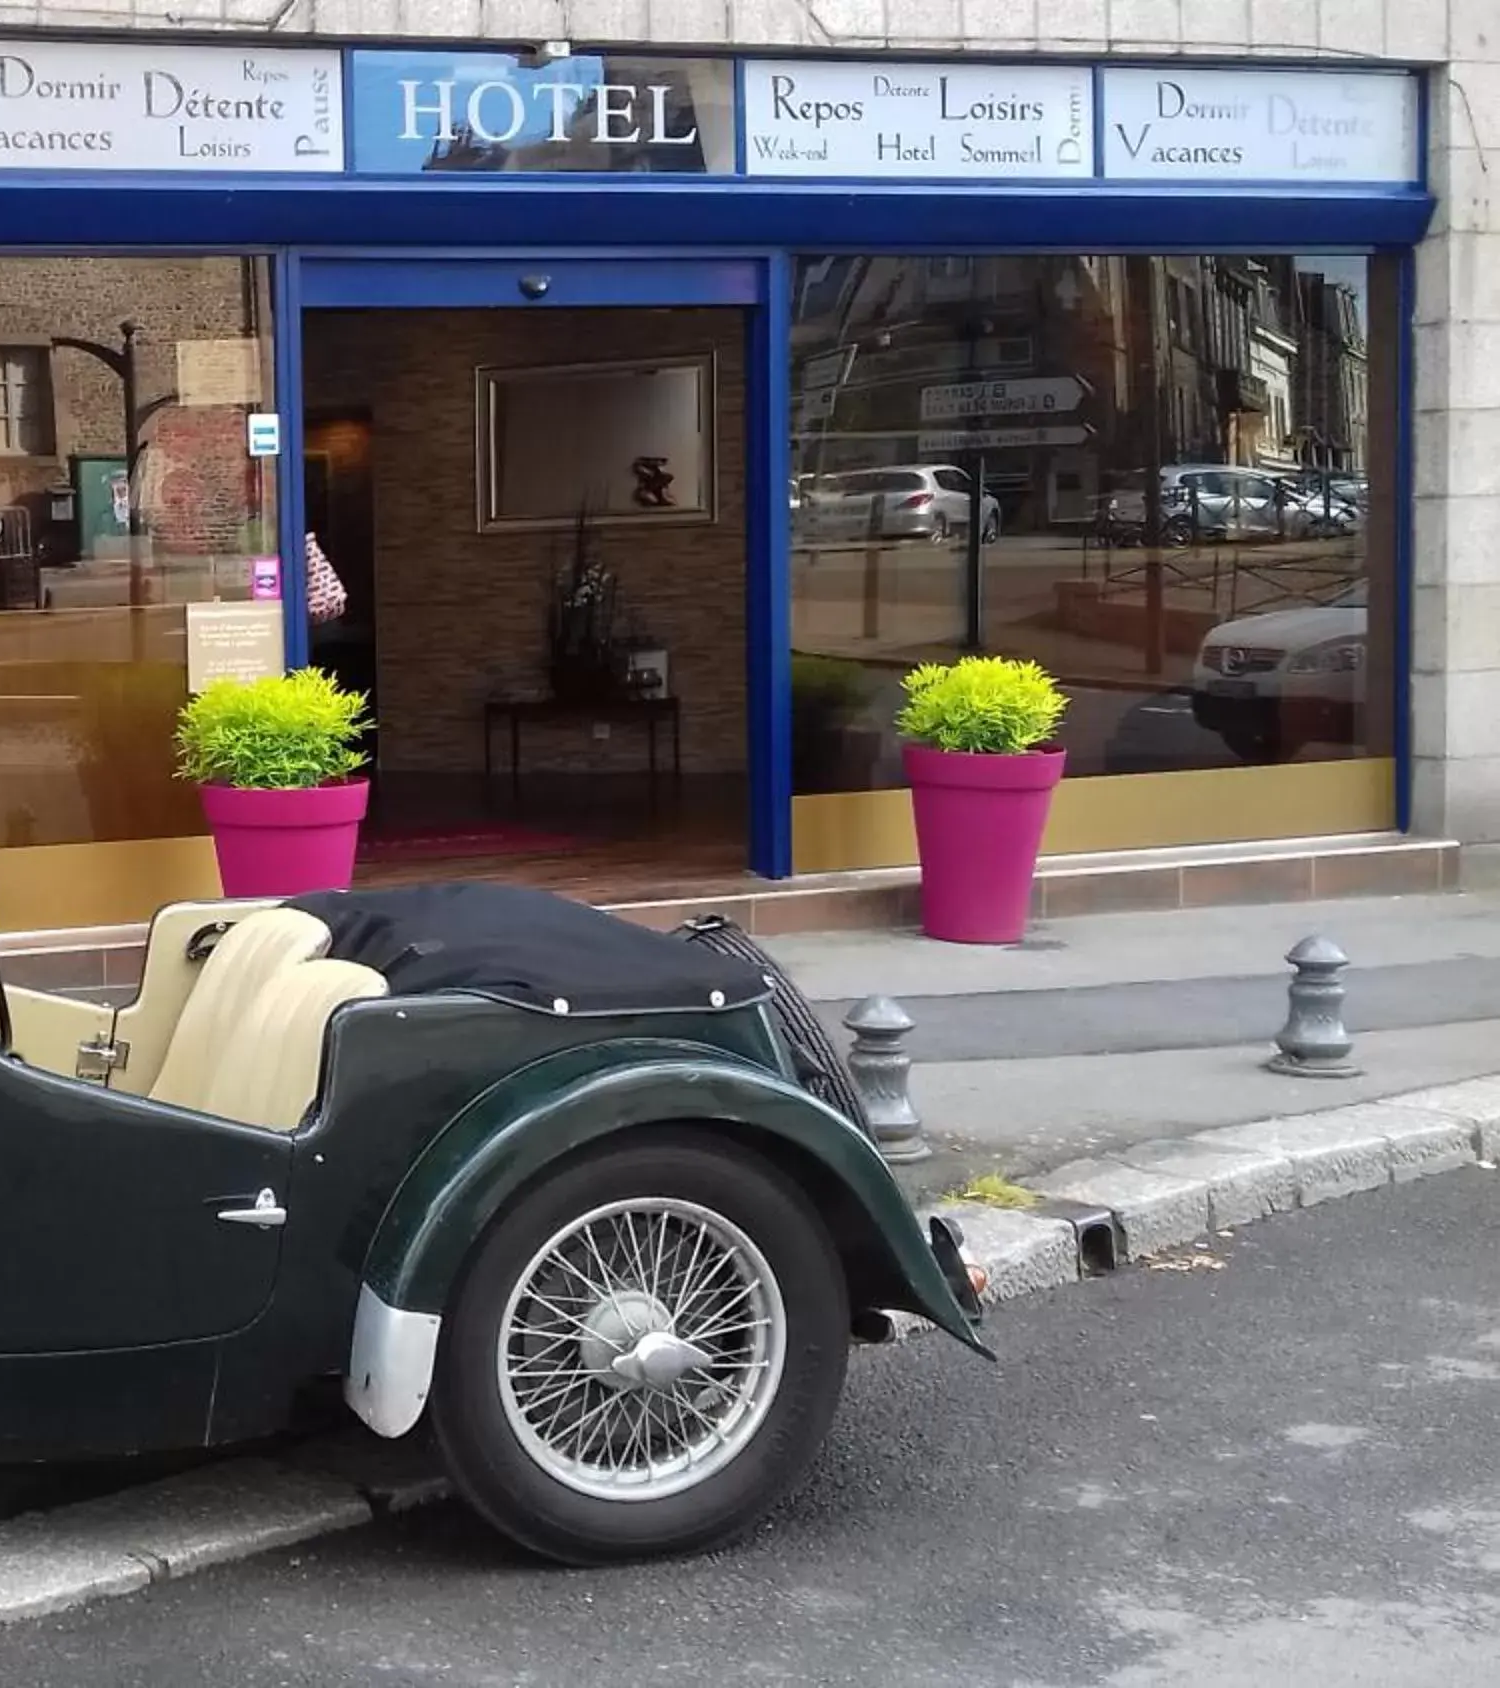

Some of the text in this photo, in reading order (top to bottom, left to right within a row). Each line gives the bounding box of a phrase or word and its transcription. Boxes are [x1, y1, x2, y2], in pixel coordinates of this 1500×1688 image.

[143, 70, 285, 119] Détente
[242, 59, 290, 84] Repos
[294, 67, 330, 157] Pause
[397, 79, 697, 145] HOTEL
[771, 75, 864, 128] Repos
[939, 76, 1044, 120] Loisirs
[1156, 81, 1249, 119] Dormir
[178, 125, 252, 158] Loisirs
[753, 132, 1041, 163] Week-end Hotel Sommeil
[1114, 123, 1243, 163] Vacances
